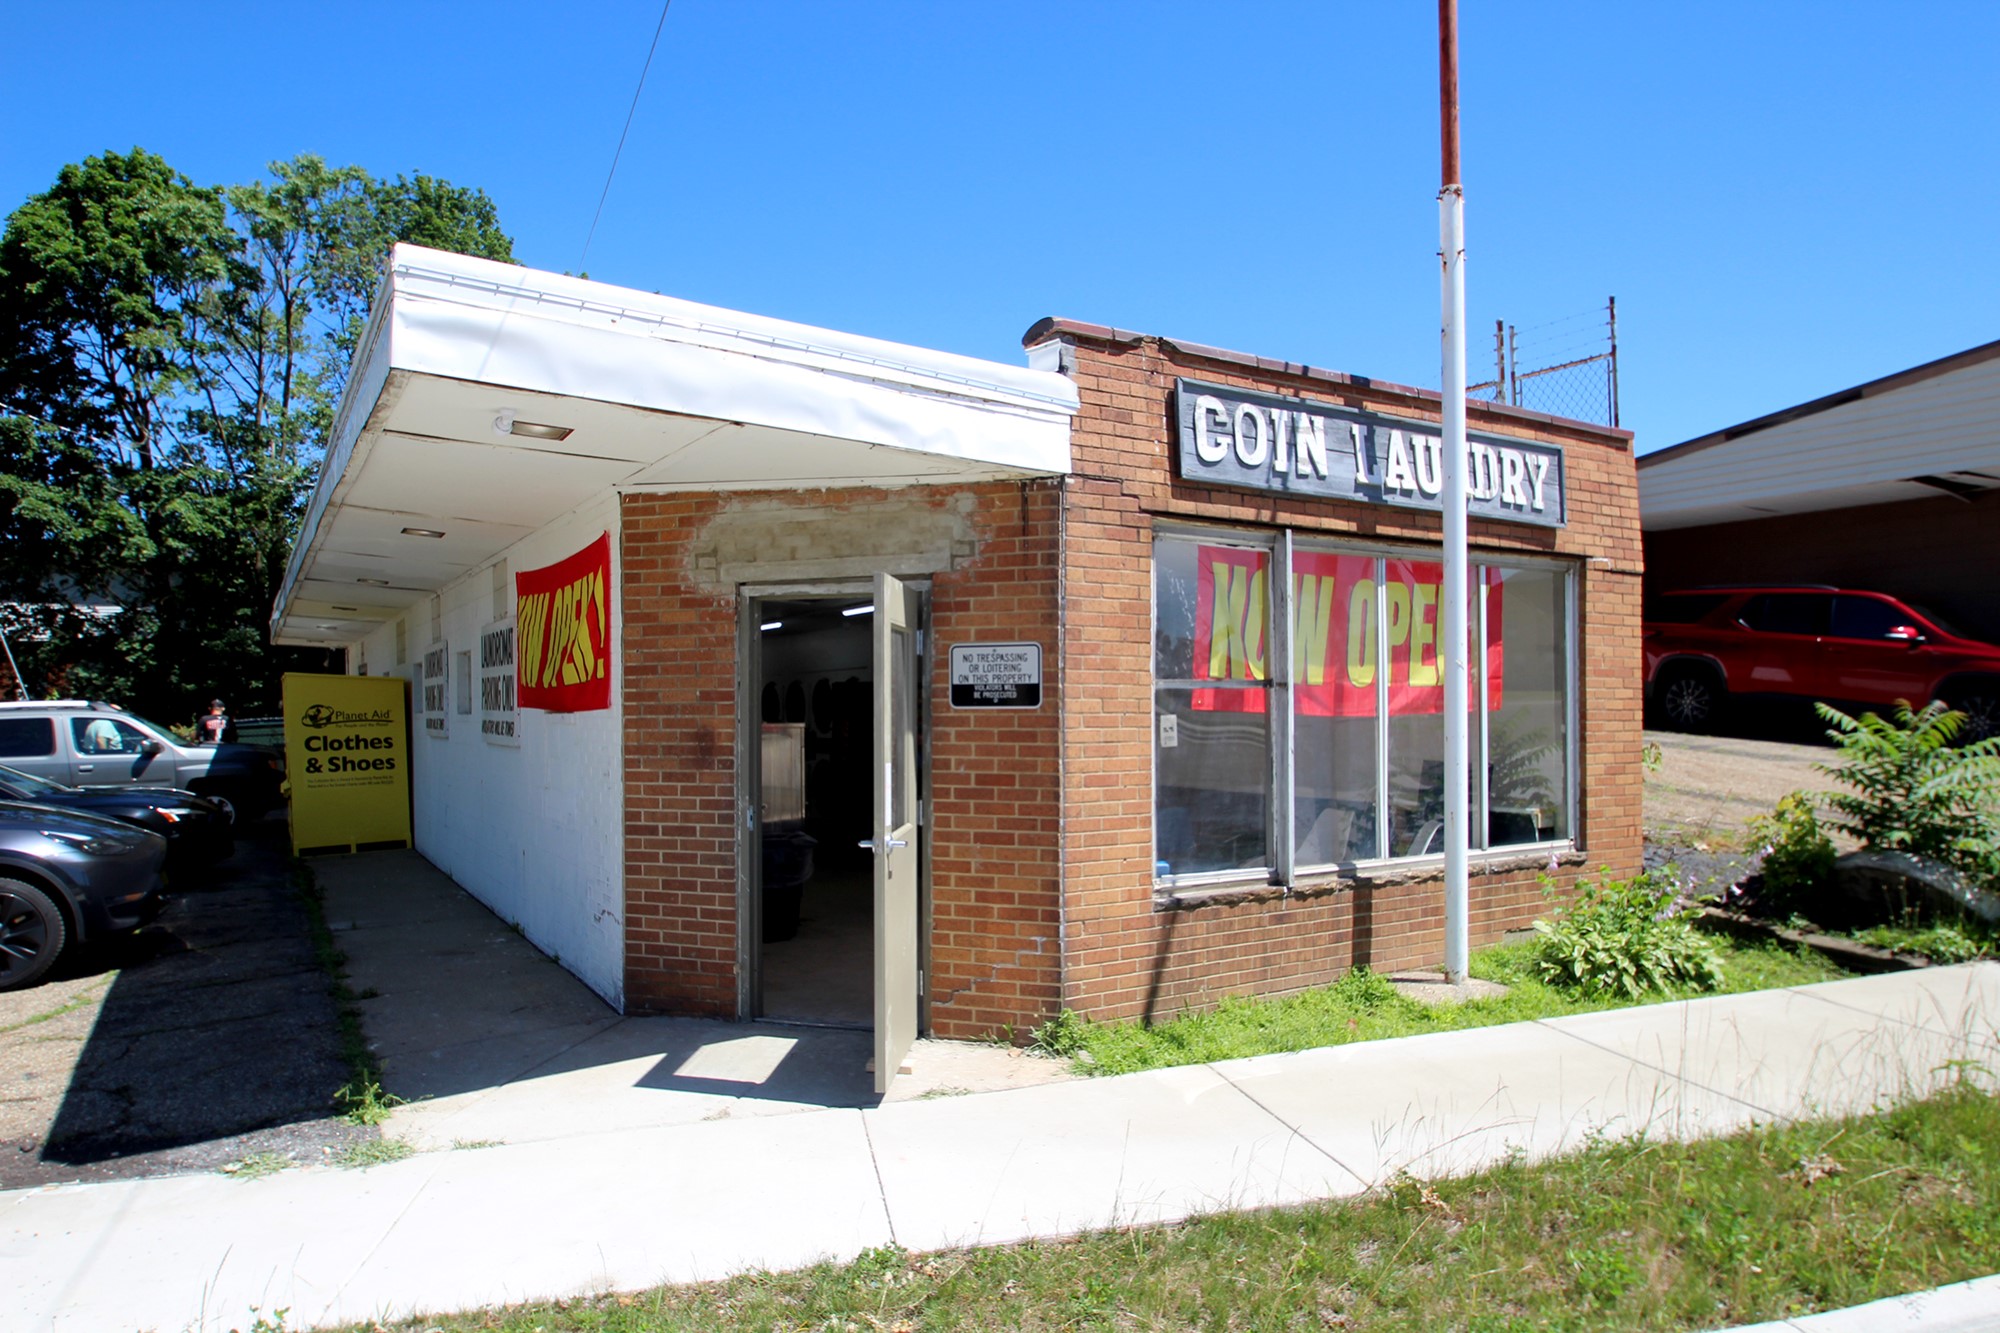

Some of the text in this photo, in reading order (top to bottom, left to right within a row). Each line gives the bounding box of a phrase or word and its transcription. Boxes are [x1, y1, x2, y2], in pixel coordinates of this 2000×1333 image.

[1194, 394, 1550, 510] COIN LAUDRY
[1346, 578, 1468, 688] OPE
[962, 652, 1028, 663] NO TRESPASSING
[968, 663, 1022, 673] OR LOITERING
[958, 673, 1032, 683] ON THIS PROPERTY
[973, 691, 981, 699] BE
[335, 709, 390, 721] Planet Aid
[304, 734, 394, 752] Clothes
[305, 756, 396, 774] & Shoes
